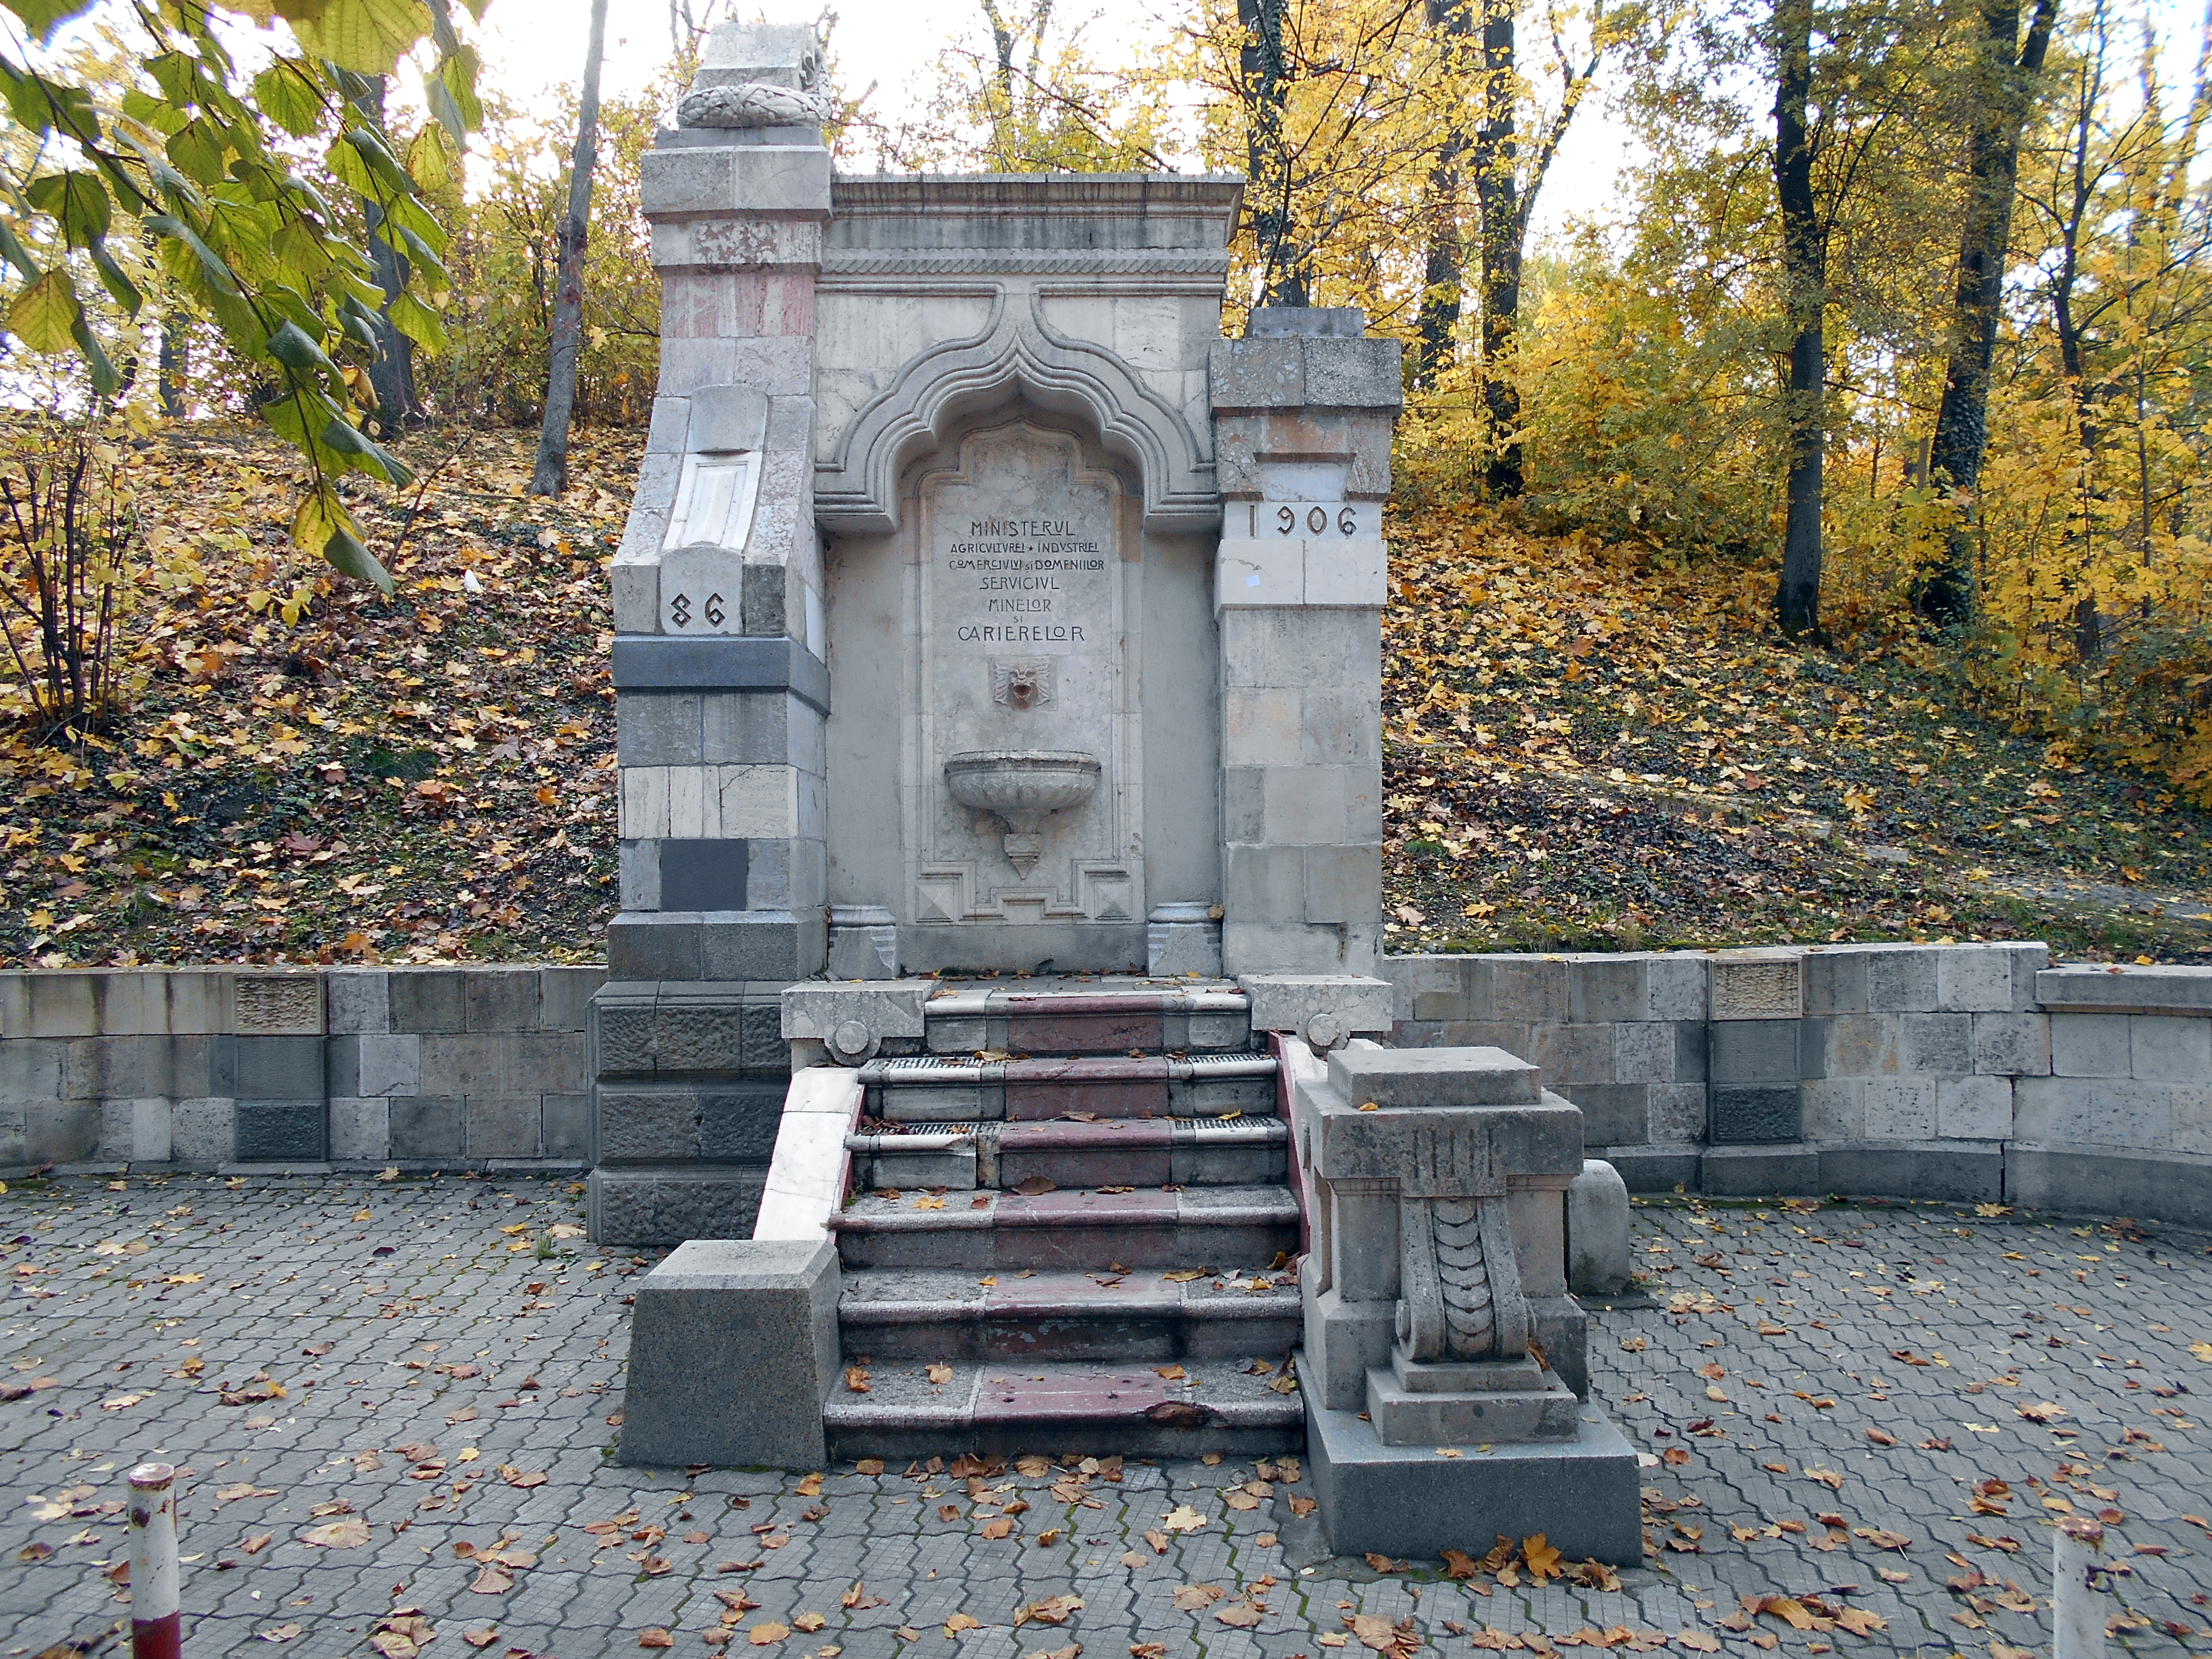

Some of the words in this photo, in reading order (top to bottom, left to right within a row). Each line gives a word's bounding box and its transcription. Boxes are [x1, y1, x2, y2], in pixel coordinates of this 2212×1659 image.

[1249, 504, 1358, 538] 1906
[972, 521, 1076, 537] MINISTERUL
[1035, 559, 1104, 570] DOMENIILOR
[670, 592, 725, 629] 86
[989, 599, 1051, 612] MINELOR
[958, 626, 1085, 641] CARIERELOR
